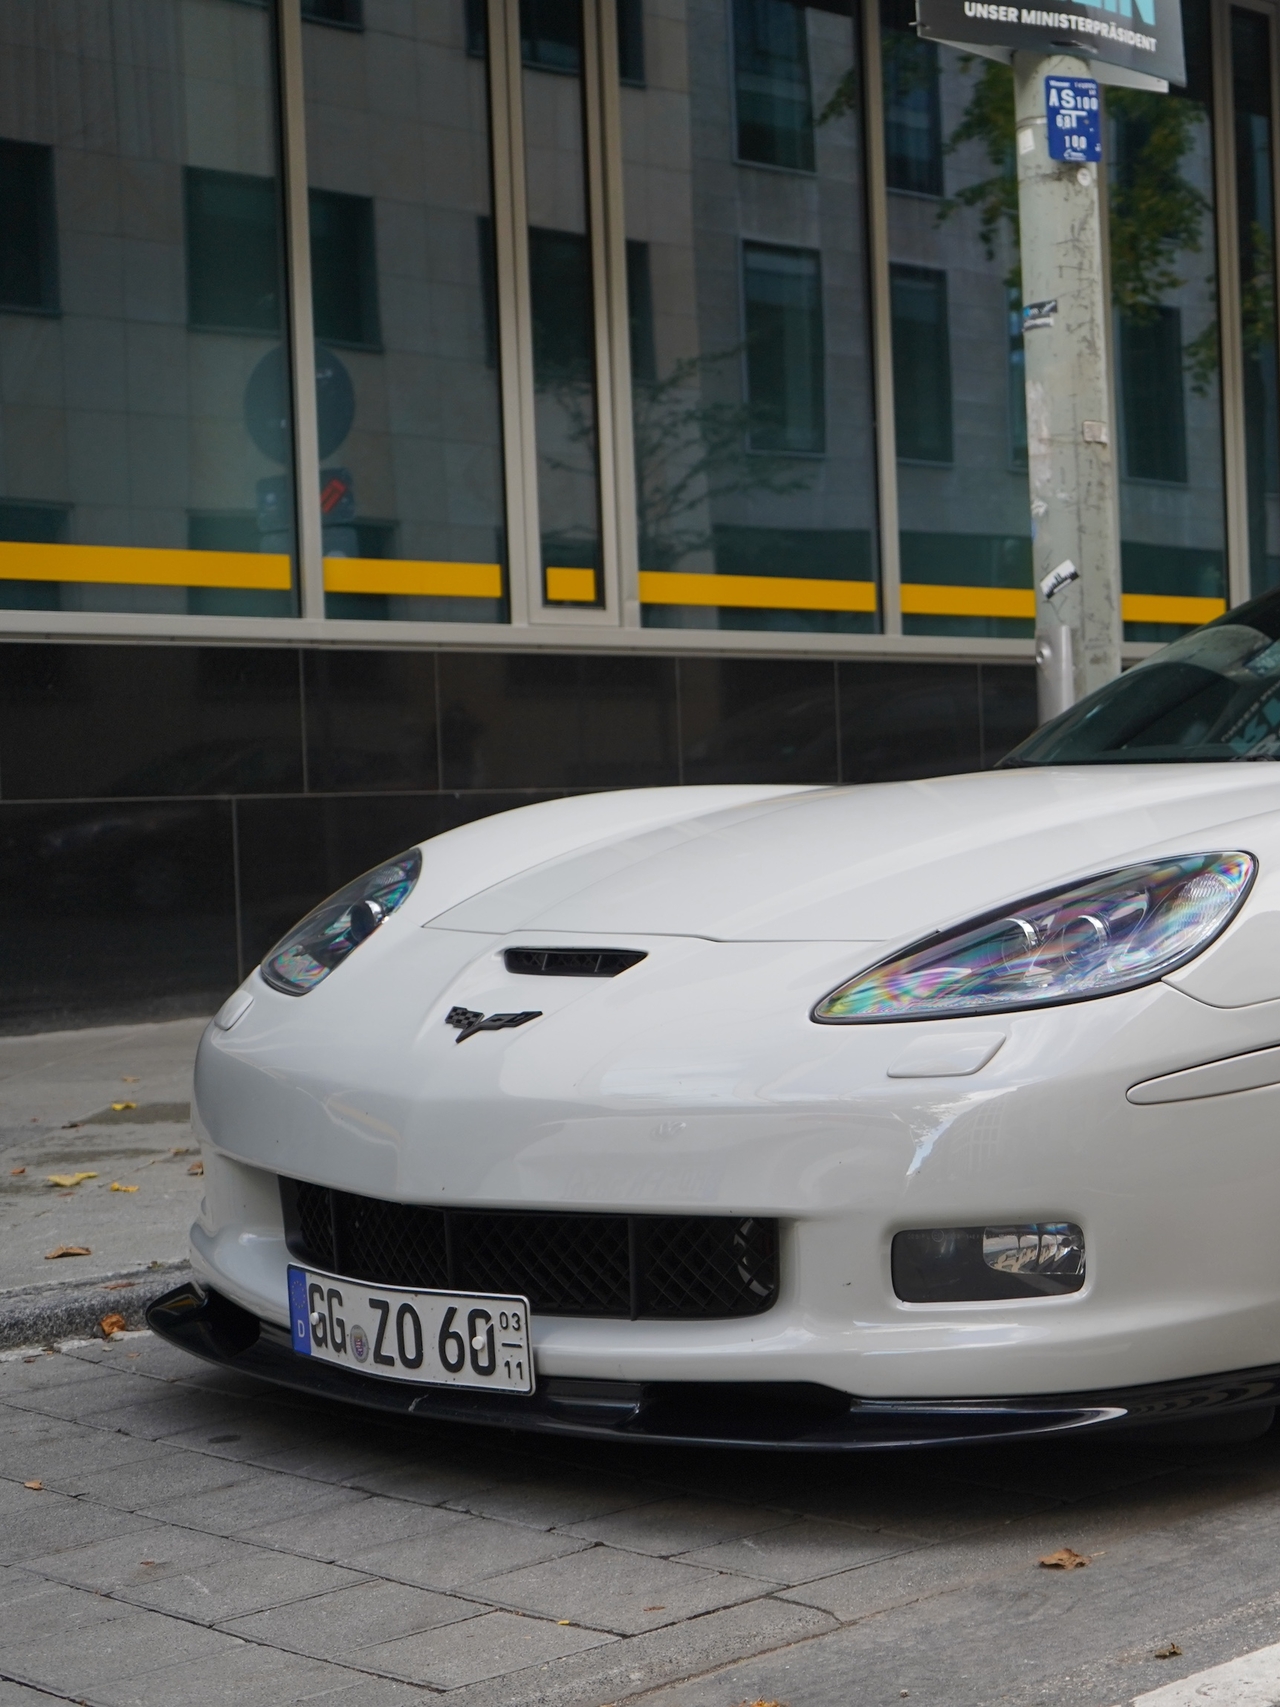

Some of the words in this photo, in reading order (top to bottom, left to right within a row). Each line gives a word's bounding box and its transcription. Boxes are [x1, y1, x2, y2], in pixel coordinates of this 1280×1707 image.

[964, 1, 1018, 23] UNSER
[1021, 10, 1157, 52] MINISTERPRÄSIDENT
[297, 1319, 306, 1338] D
[308, 1282, 347, 1355] GG
[438, 1306, 497, 1376] 60
[500, 1311, 521, 1331] 03
[504, 1360, 523, 1380] 11
